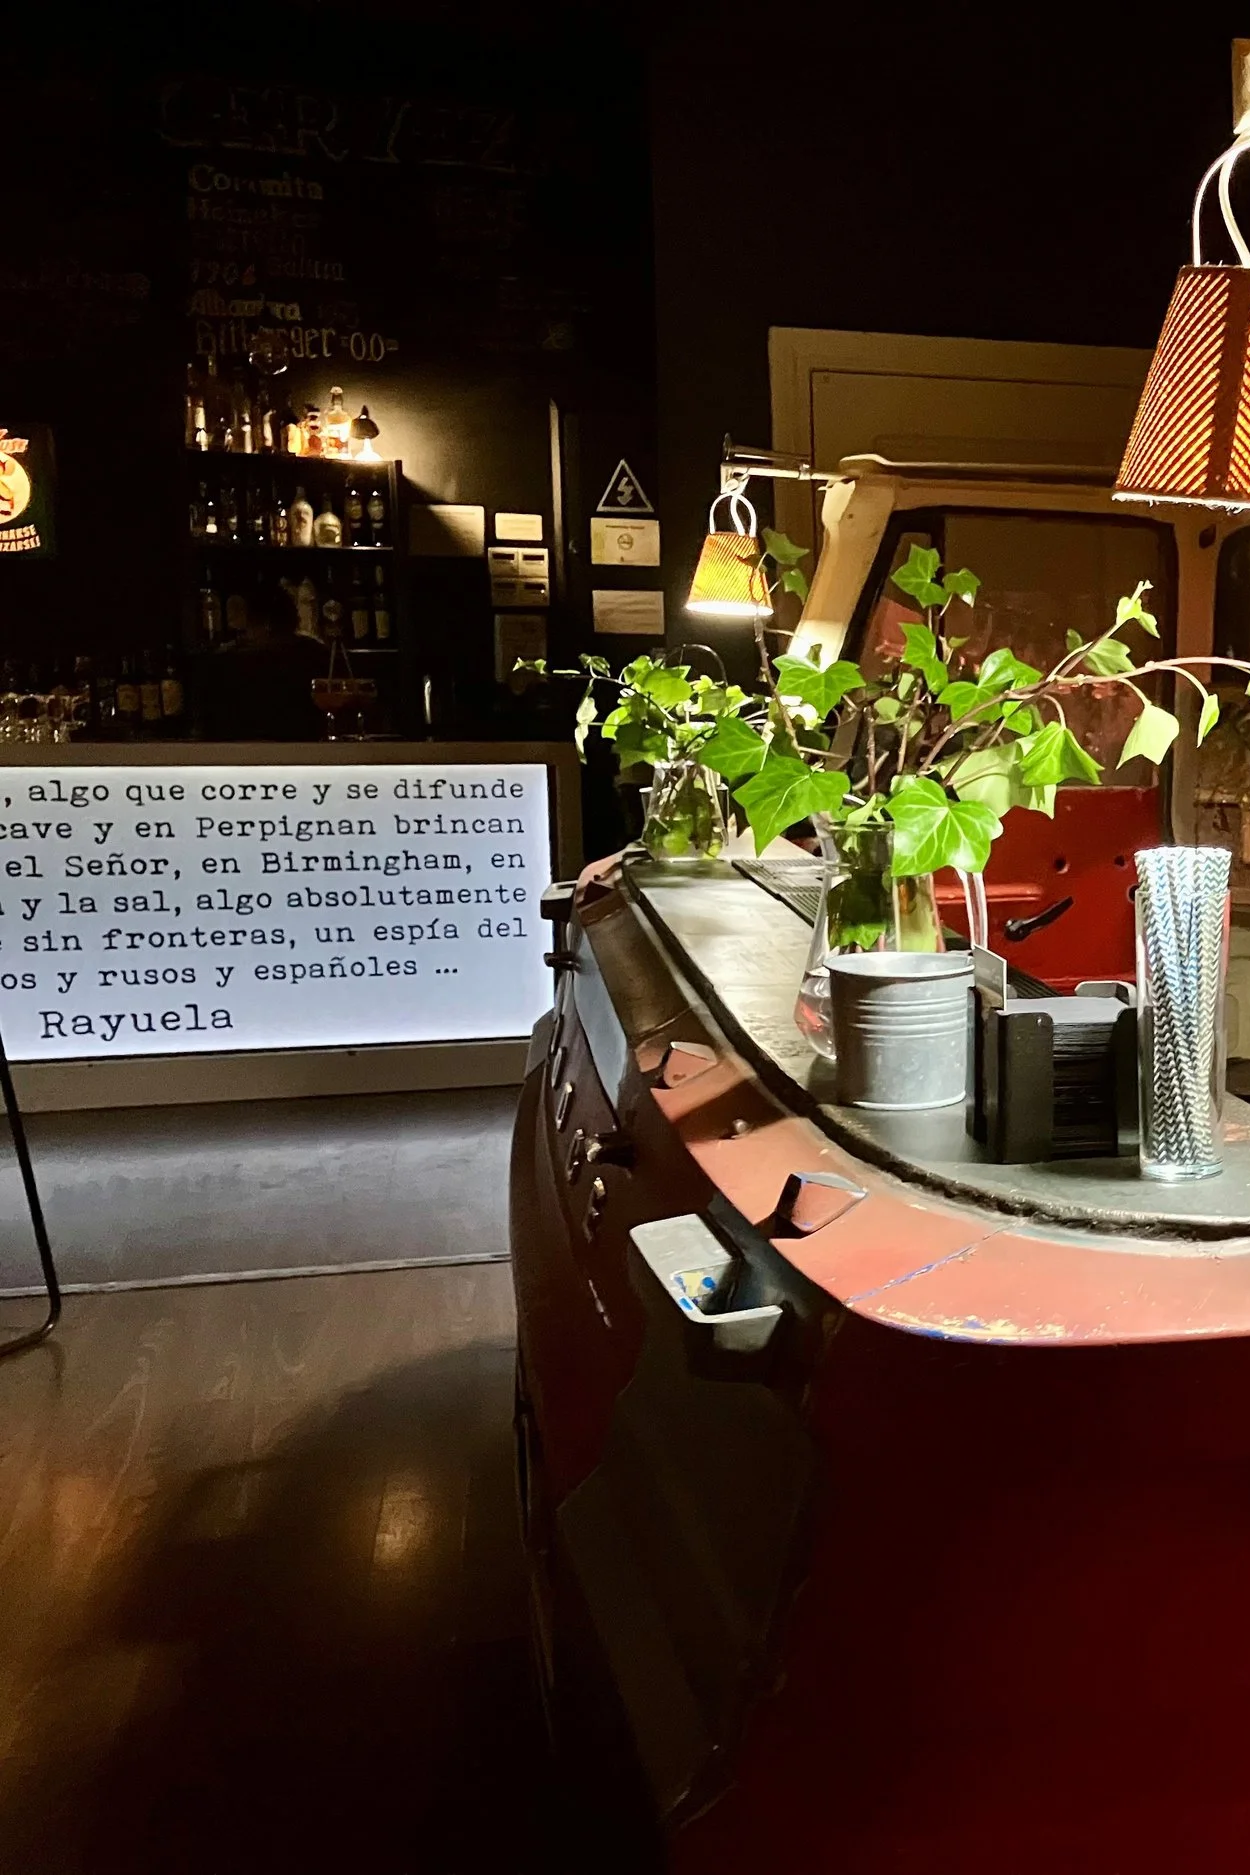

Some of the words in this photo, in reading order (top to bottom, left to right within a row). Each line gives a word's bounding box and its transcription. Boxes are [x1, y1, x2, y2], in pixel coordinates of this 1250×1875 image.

[28, 780, 109, 808] algo
[126, 785, 184, 806] que
[202, 784, 296, 800] corre
[313, 784, 330, 805] y
[347, 784, 378, 799] se
[394, 779, 523, 799] difunde
[93, 823, 113, 844] y
[135, 822, 175, 838] en
[196, 815, 376, 842] Perpignan
[394, 814, 524, 834] brincan
[5, 855, 43, 877] el
[65, 853, 180, 880] Señor,
[202, 858, 241, 874] en
[261, 850, 471, 876] Birmingham,
[491, 853, 525, 868] en
[21, 899, 42, 921] y
[58, 892, 98, 914] la
[114, 890, 181, 917] sal,
[197, 889, 272, 915] algo
[287, 884, 526, 907] absolutamente
[24, 930, 82, 952] sin
[102, 927, 295, 950] fronteras,
[315, 927, 355, 943] un
[374, 918, 459, 945] espía
[478, 917, 527, 938] del
[57, 972, 77, 994] y
[98, 968, 196, 986] rusos
[216, 966, 234, 988] y
[255, 956, 417, 984] españoles
[39, 1004, 233, 1041] Rayuela
